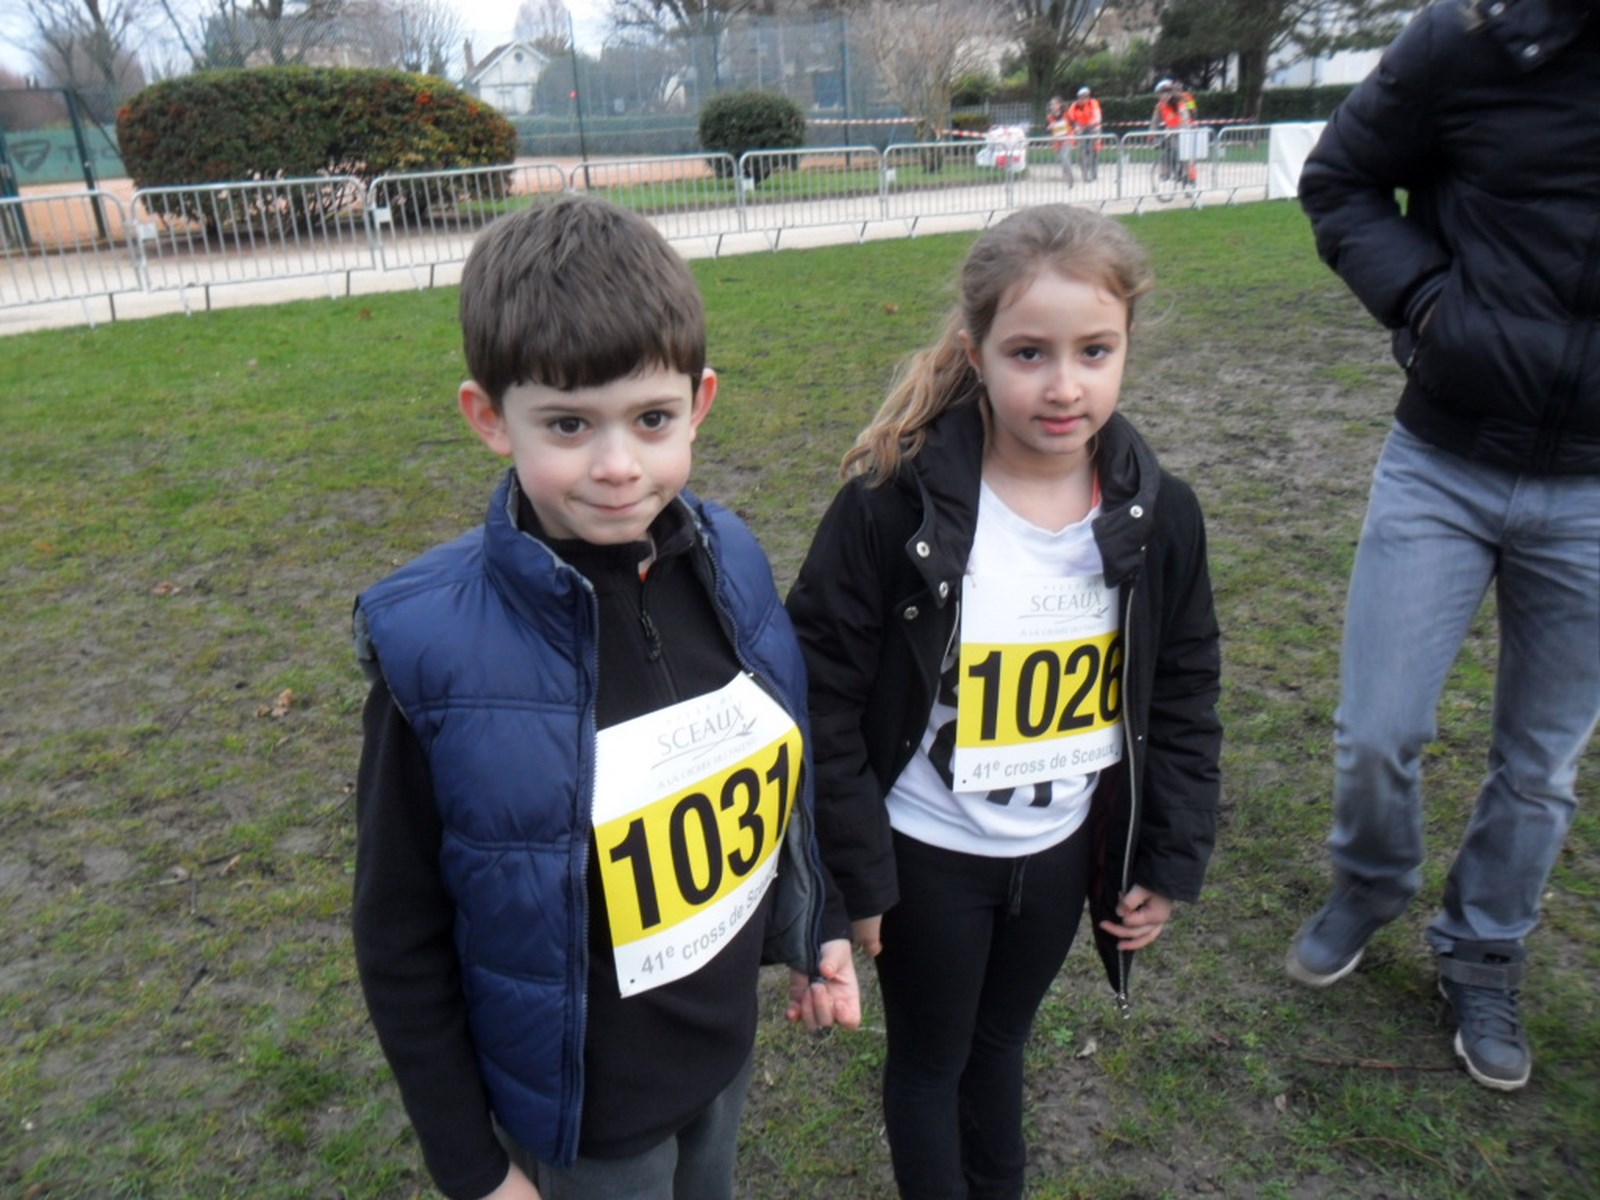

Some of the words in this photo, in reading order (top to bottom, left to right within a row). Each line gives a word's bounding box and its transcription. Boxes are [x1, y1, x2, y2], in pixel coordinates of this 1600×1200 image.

[1030, 587, 1103, 613] SCEAUX
[968, 636, 1122, 741] 1026
[656, 700, 745, 757] SCEAUX
[1004, 757, 1046, 777] cross
[1049, 752, 1067, 771] de
[609, 742, 790, 931] 1031
[682, 920, 727, 962] cross
[729, 903, 745, 928] de
